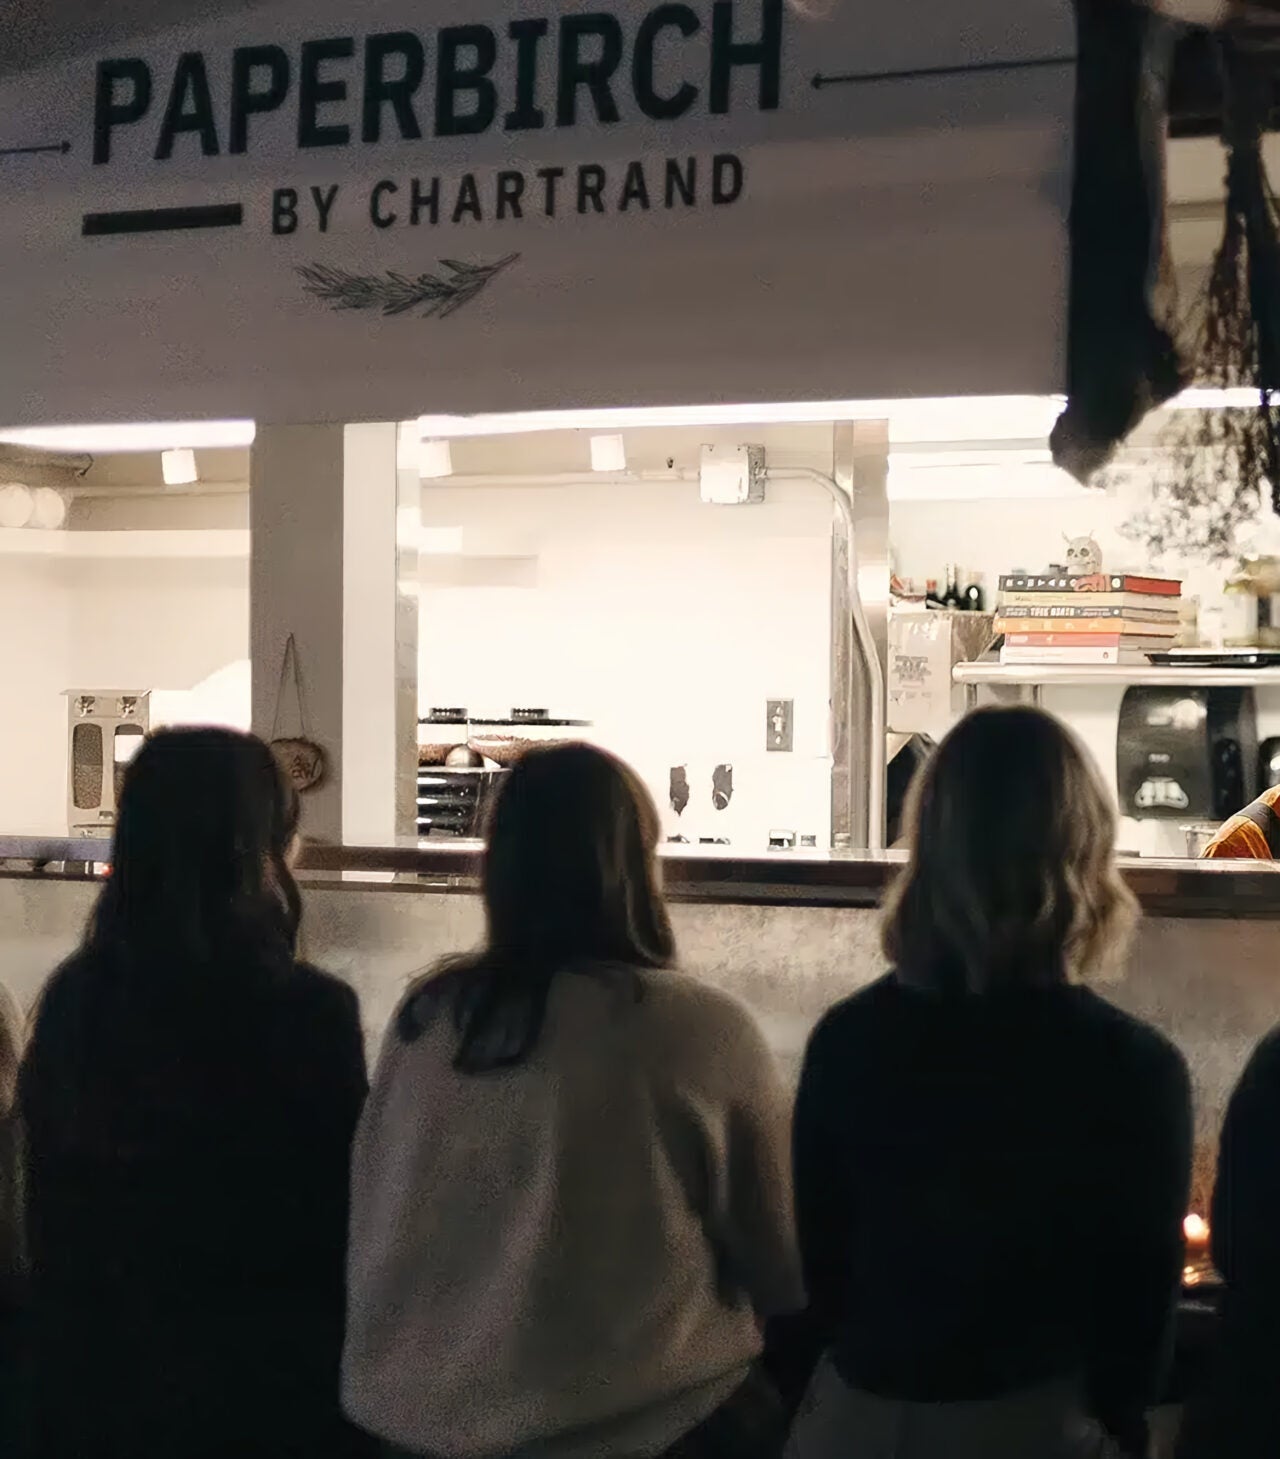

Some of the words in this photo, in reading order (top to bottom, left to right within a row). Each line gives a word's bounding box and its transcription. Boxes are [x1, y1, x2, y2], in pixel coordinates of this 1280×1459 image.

[92, 0, 784, 165] PAPERBIRCH
[271, 185, 340, 235] BY
[369, 153, 745, 230] CHARTRAND
